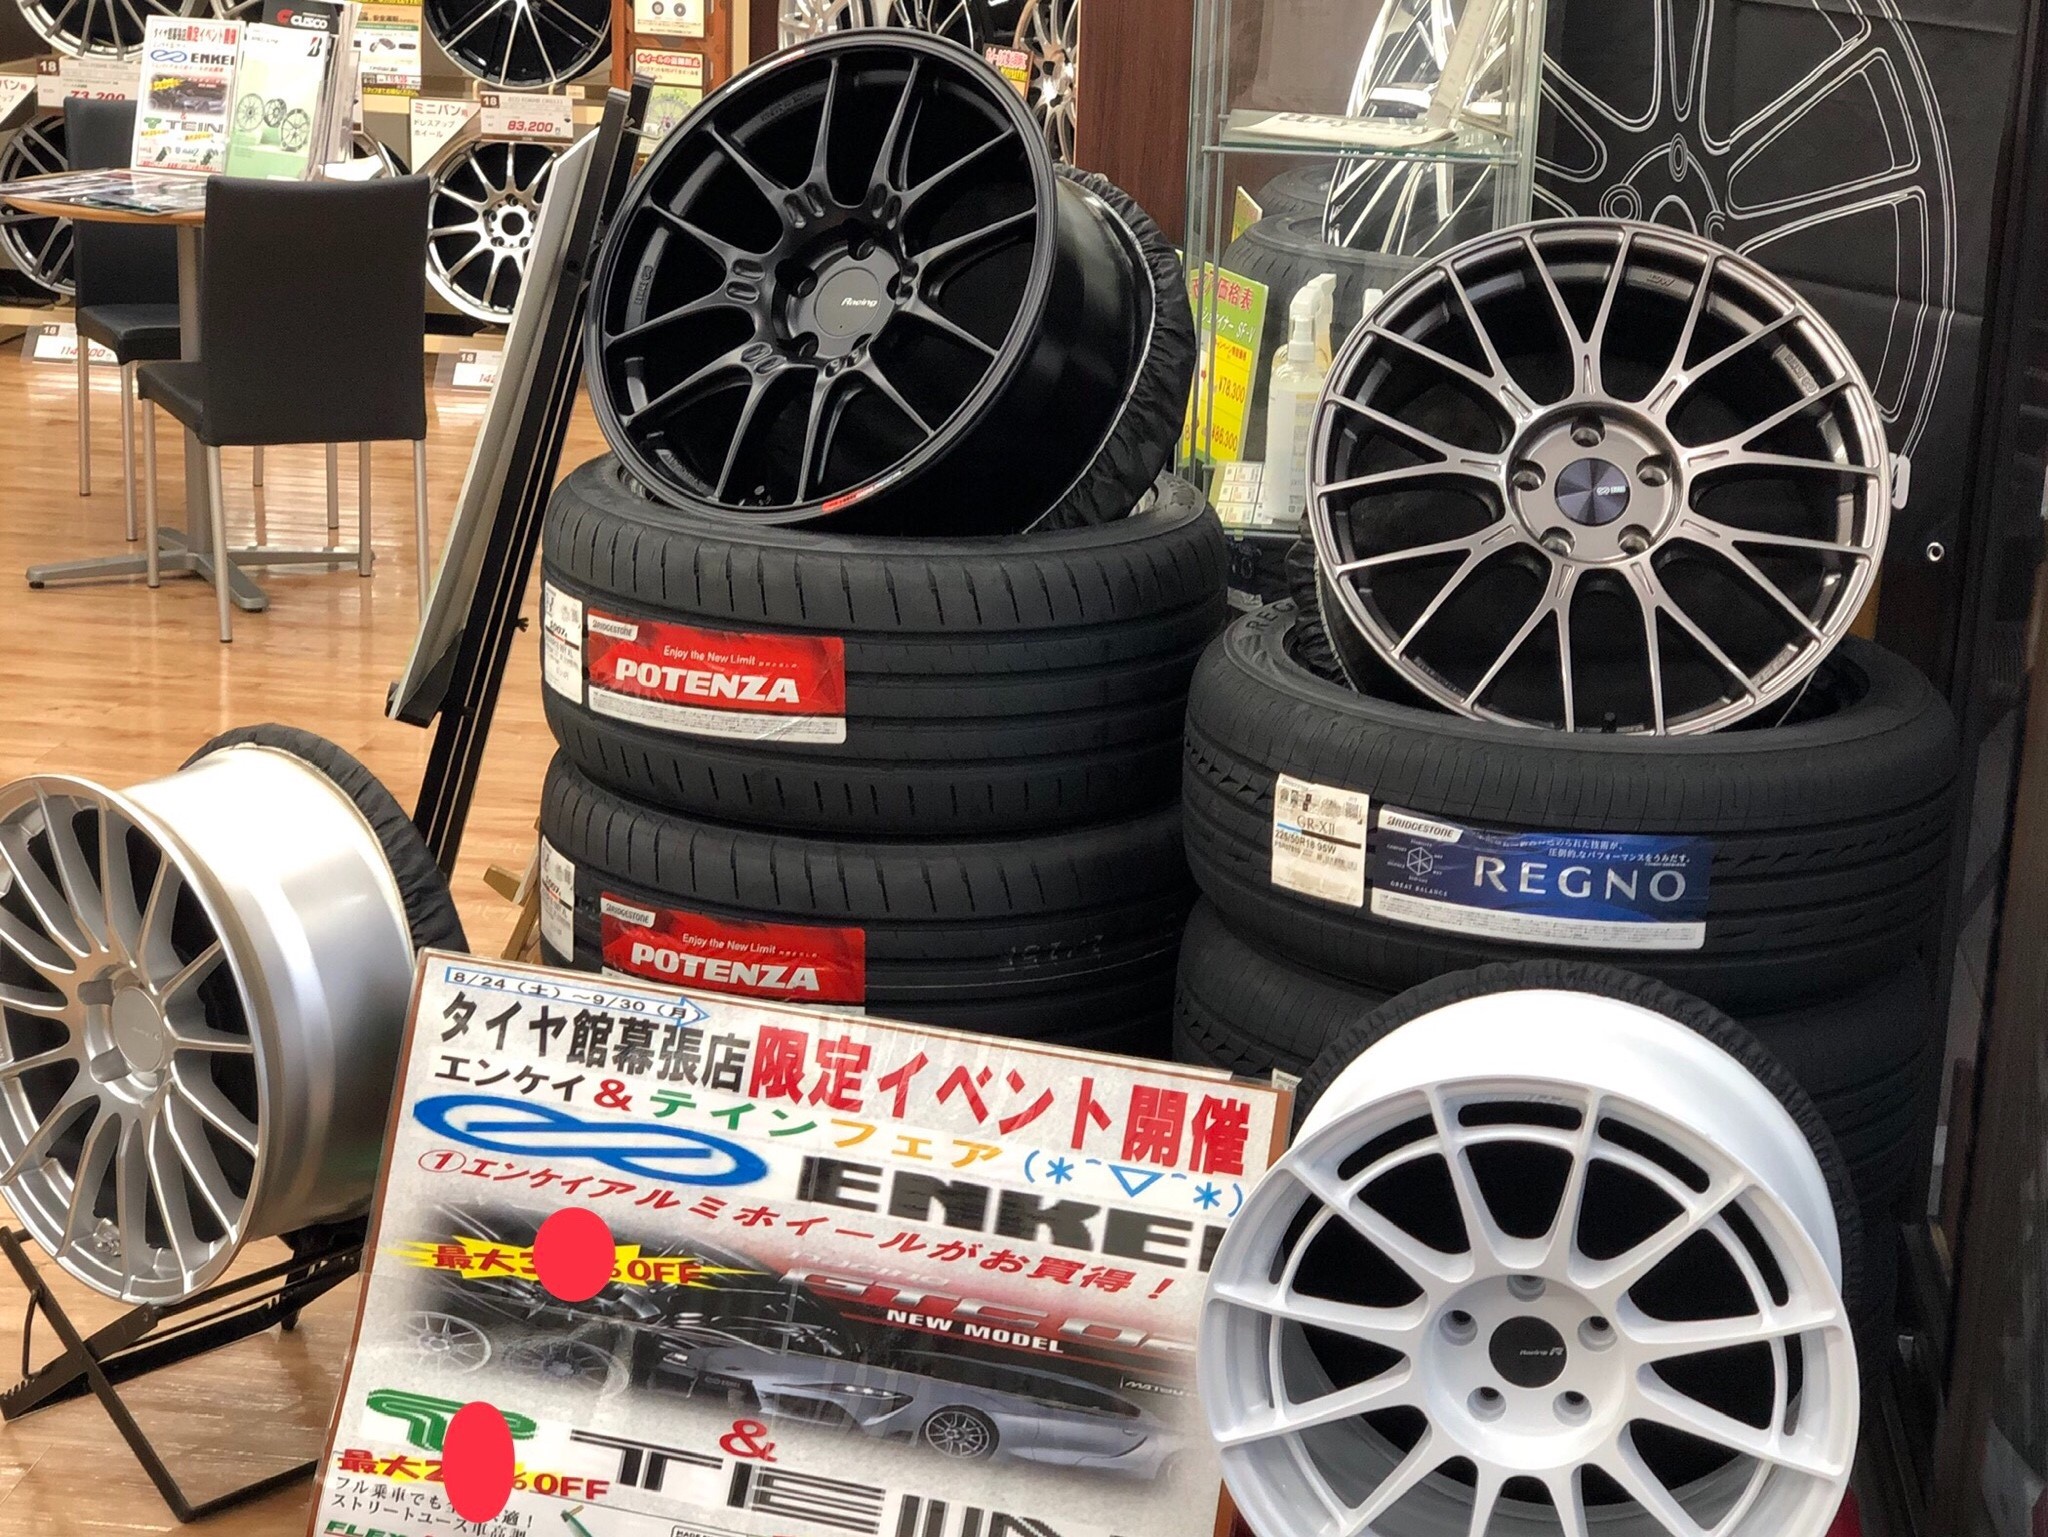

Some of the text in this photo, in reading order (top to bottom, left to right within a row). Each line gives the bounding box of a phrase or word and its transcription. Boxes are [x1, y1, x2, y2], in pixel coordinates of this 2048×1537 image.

[291, 15, 328, 29] CUSCO
[39, 61, 57, 72] 18
[190, 53, 235, 66] ENKEI
[483, 96, 497, 105] 18
[166, 119, 224, 133] TEIN
[507, 120, 554, 132] 83,200
[841, 297, 878, 308] Racing
[461, 353, 474, 362] 18
[664, 645, 756, 666] Enjoy the New Limit
[615, 657, 800, 703] POTENZA
[1386, 816, 1454, 838] BRIDGESTONE
[1473, 854, 1687, 902] REGNO
[1390, 880, 1448, 897] GREAT BALANCE
[682, 933, 777, 954] Enjoy the New Limit
[631, 942, 820, 991] POTENZA
[886, 1309, 1065, 1355] NEW MODEL
[718, 1418, 778, 1463] &
